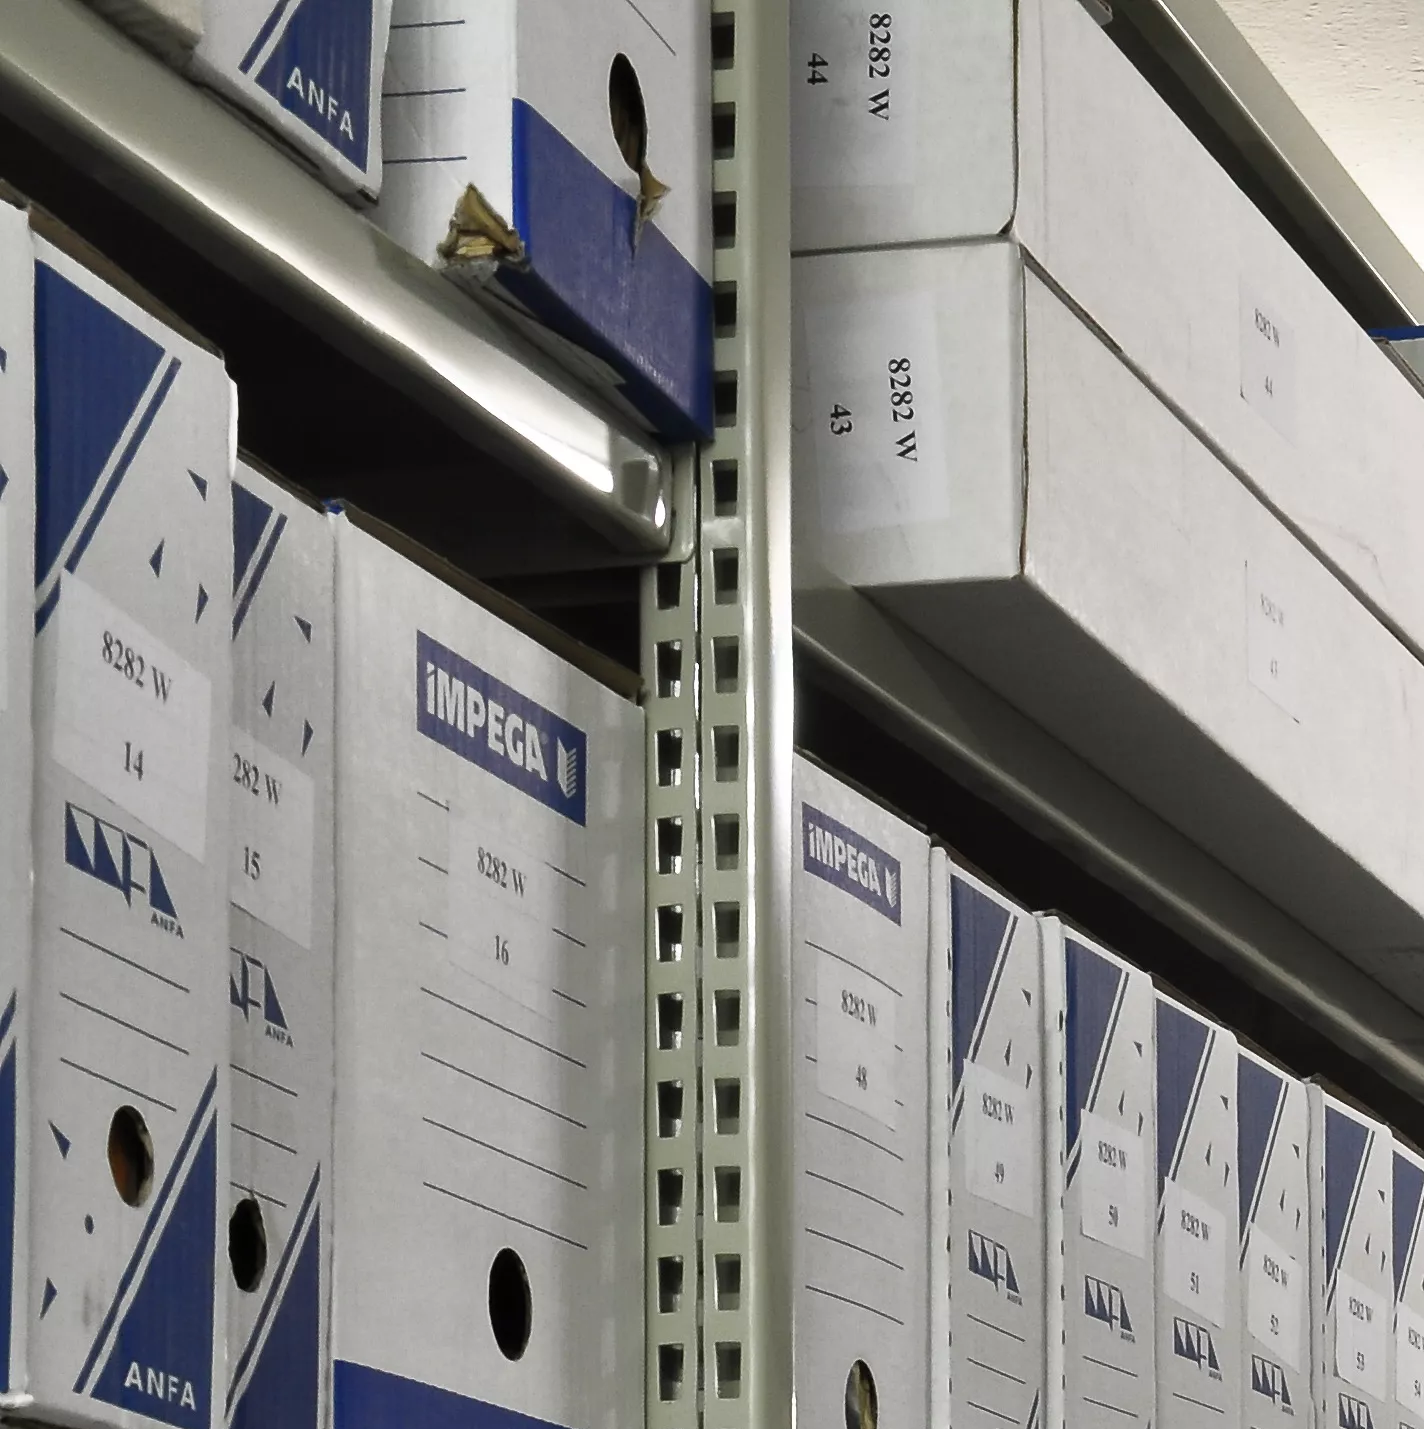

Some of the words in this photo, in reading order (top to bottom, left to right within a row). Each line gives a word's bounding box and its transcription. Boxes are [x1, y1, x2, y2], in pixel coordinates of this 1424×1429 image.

[868, 13, 893, 79] 8282
[807, 52, 828, 86] 44
[287, 66, 354, 141] ANFA
[868, 89, 890, 121] W
[888, 358, 915, 423] 8282
[829, 404, 853, 436] 43
[895, 430, 918, 462] W
[102, 631, 145, 687] 8282
[150, 674, 172, 702] W
[123, 743, 143, 780] 14
[266, 775, 282, 804] W
[243, 847, 260, 880] 15
[477, 847, 507, 895] 8282
[511, 873, 527, 897] W
[151, 914, 184, 938] ANFA
[494, 935, 509, 965] 16
[841, 989, 864, 1023] 8282
[867, 1005, 876, 1026] W
[265, 1025, 294, 1047] ANFA
[856, 1066, 867, 1090] 48
[982, 1092, 1003, 1123] 8282
[1005, 1104, 1014, 1125] W
[1098, 1140, 1117, 1168] 8282
[1118, 1150, 1127, 1170] W
[995, 1161, 1004, 1184] 49
[1108, 1205, 1118, 1227] 50
[1181, 1209, 1198, 1240] 8282
[1199, 1221, 1208, 1242] W
[1190, 1273, 1199, 1294] 51
[1263, 1256, 1281, 1282] 8282
[1270, 1316, 1278, 1335] 52
[1356, 1353, 1364, 1371] 53
[125, 1362, 196, 1410] ANFA
